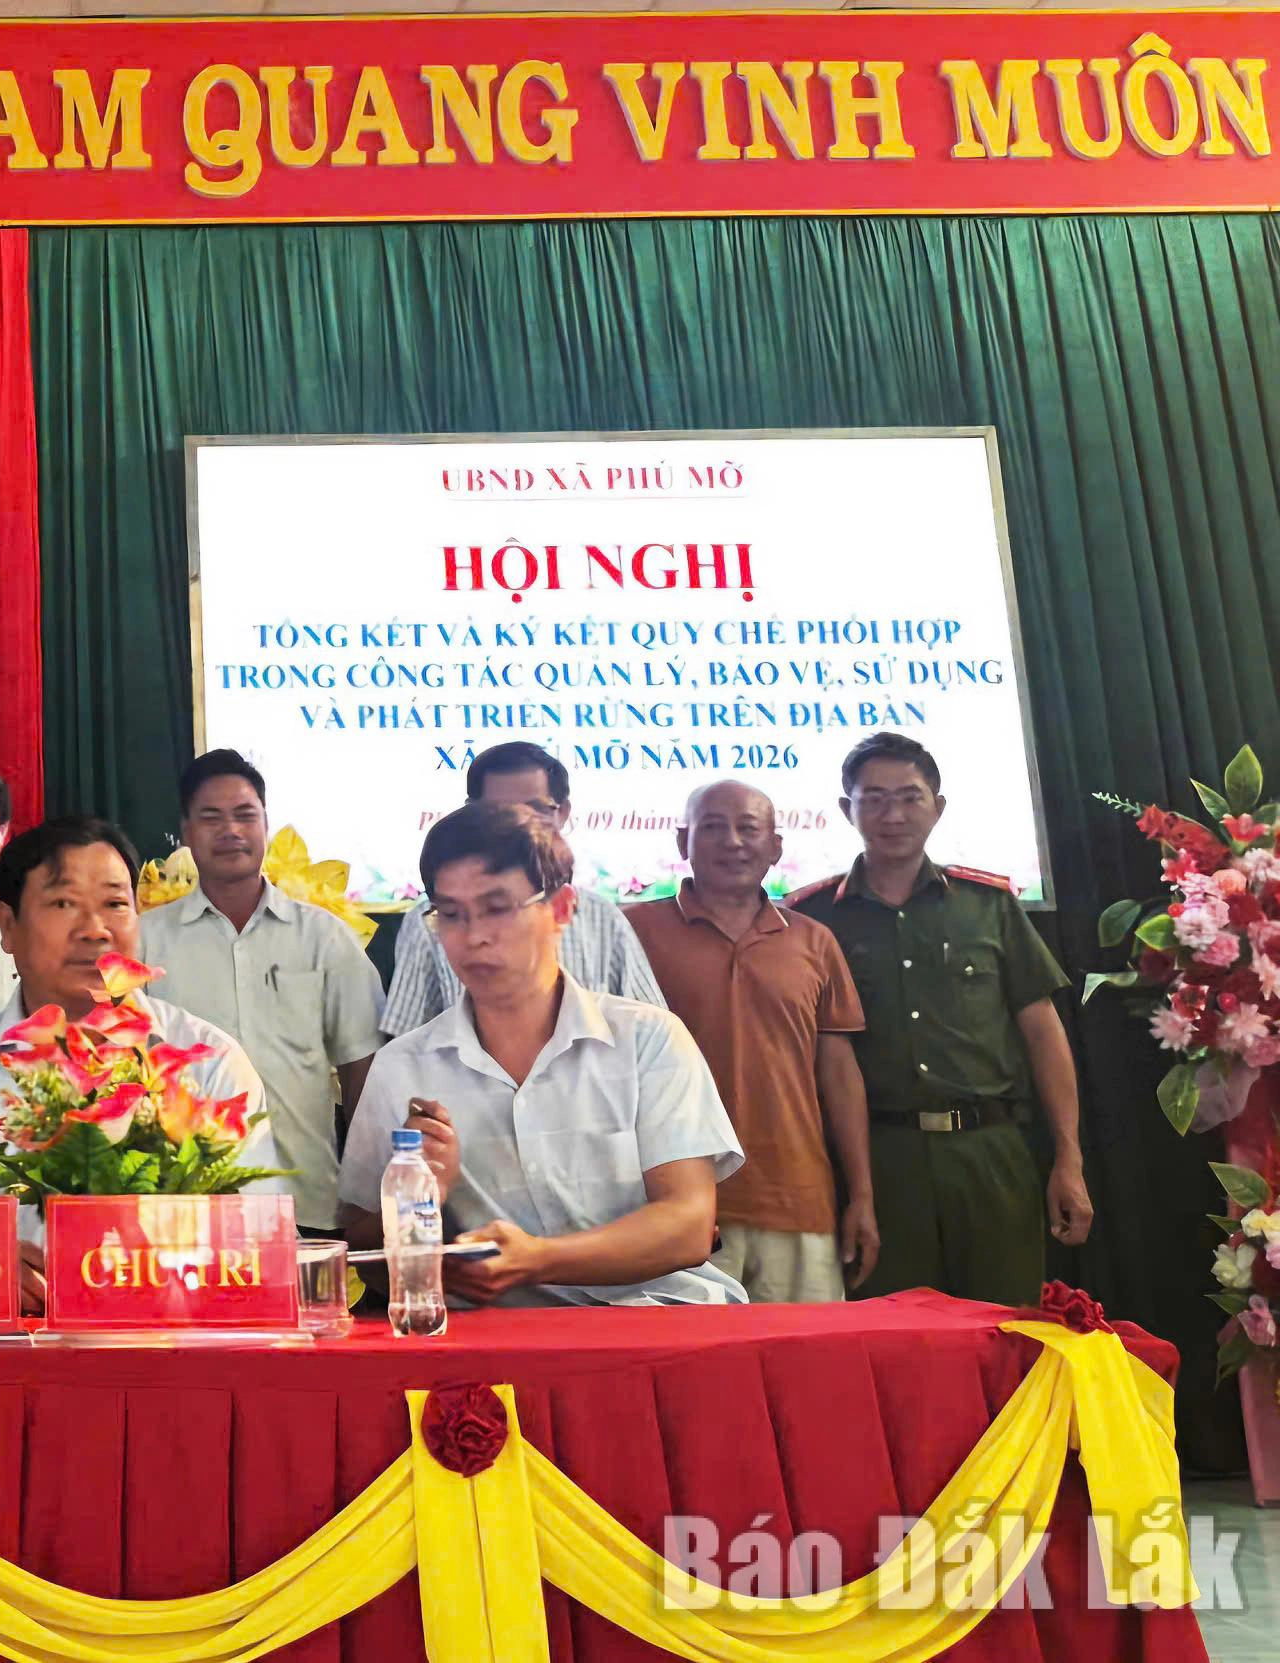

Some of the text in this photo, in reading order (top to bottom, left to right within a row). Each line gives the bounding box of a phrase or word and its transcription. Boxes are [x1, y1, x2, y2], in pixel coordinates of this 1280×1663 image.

[183, 62, 578, 198] QUANG
[602, 60, 916, 161] VINH
[941, 31, 1273, 159] MUÔN
[441, 467, 535, 492] UBND
[545, 461, 593, 491] XÃ
[440, 536, 758, 604] HỘI NGHỊ
[630, 620, 704, 651] QUY
[891, 619, 962, 650] HỢP
[215, 664, 337, 689] TRONG
[345, 655, 445, 689] CÔNG
[453, 655, 523, 688] TÁC
[642, 654, 699, 689] LÝ,
[907, 659, 1003, 691] DỤNG
[299, 697, 347, 729] VÀ
[356, 697, 448, 729] PHÁT
[683, 695, 777, 727] TRÊN
[788, 702, 849, 733] ĐỊA
[640, 738, 720, 770] NĂM
[730, 744, 799, 769] 2026
[587, 811, 614, 829] 09
[620, 809, 680, 834] thán
